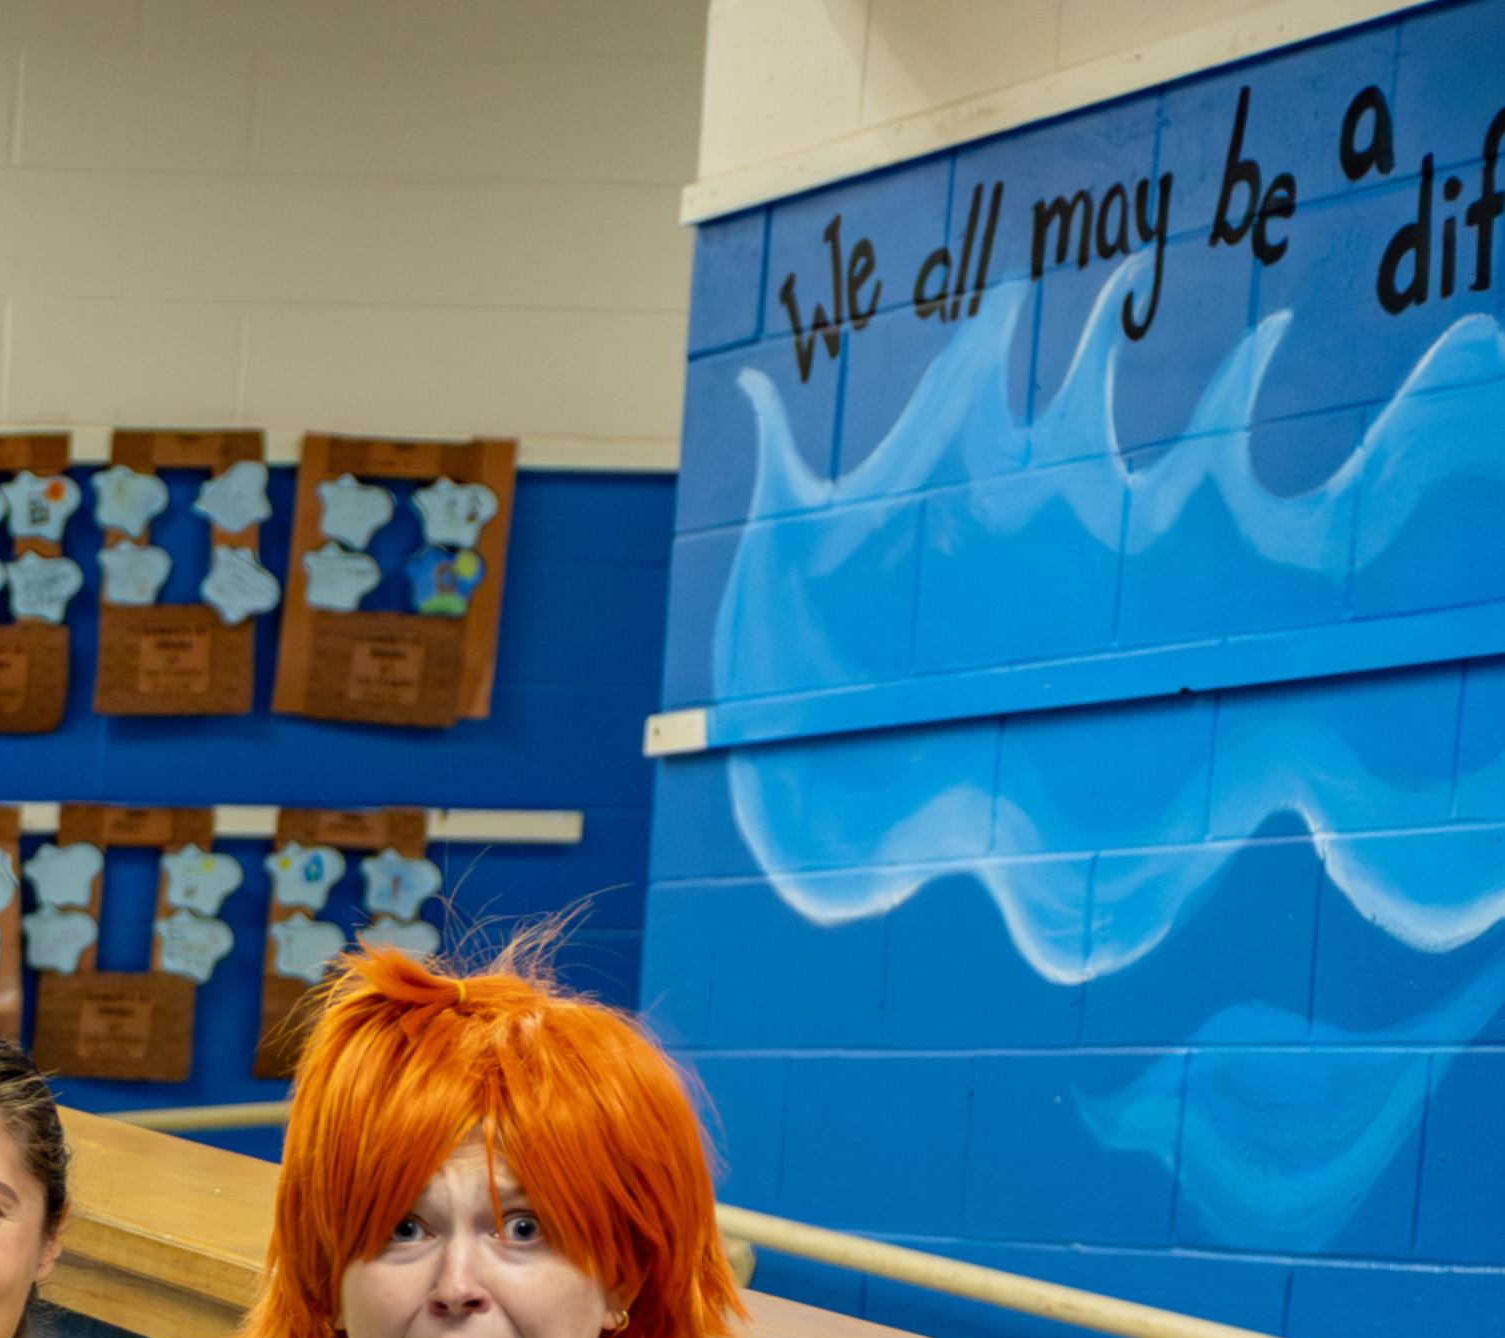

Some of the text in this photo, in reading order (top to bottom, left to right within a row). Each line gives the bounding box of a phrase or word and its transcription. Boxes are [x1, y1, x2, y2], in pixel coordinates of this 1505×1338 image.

[779, 84, 1395, 384] We all may be a
